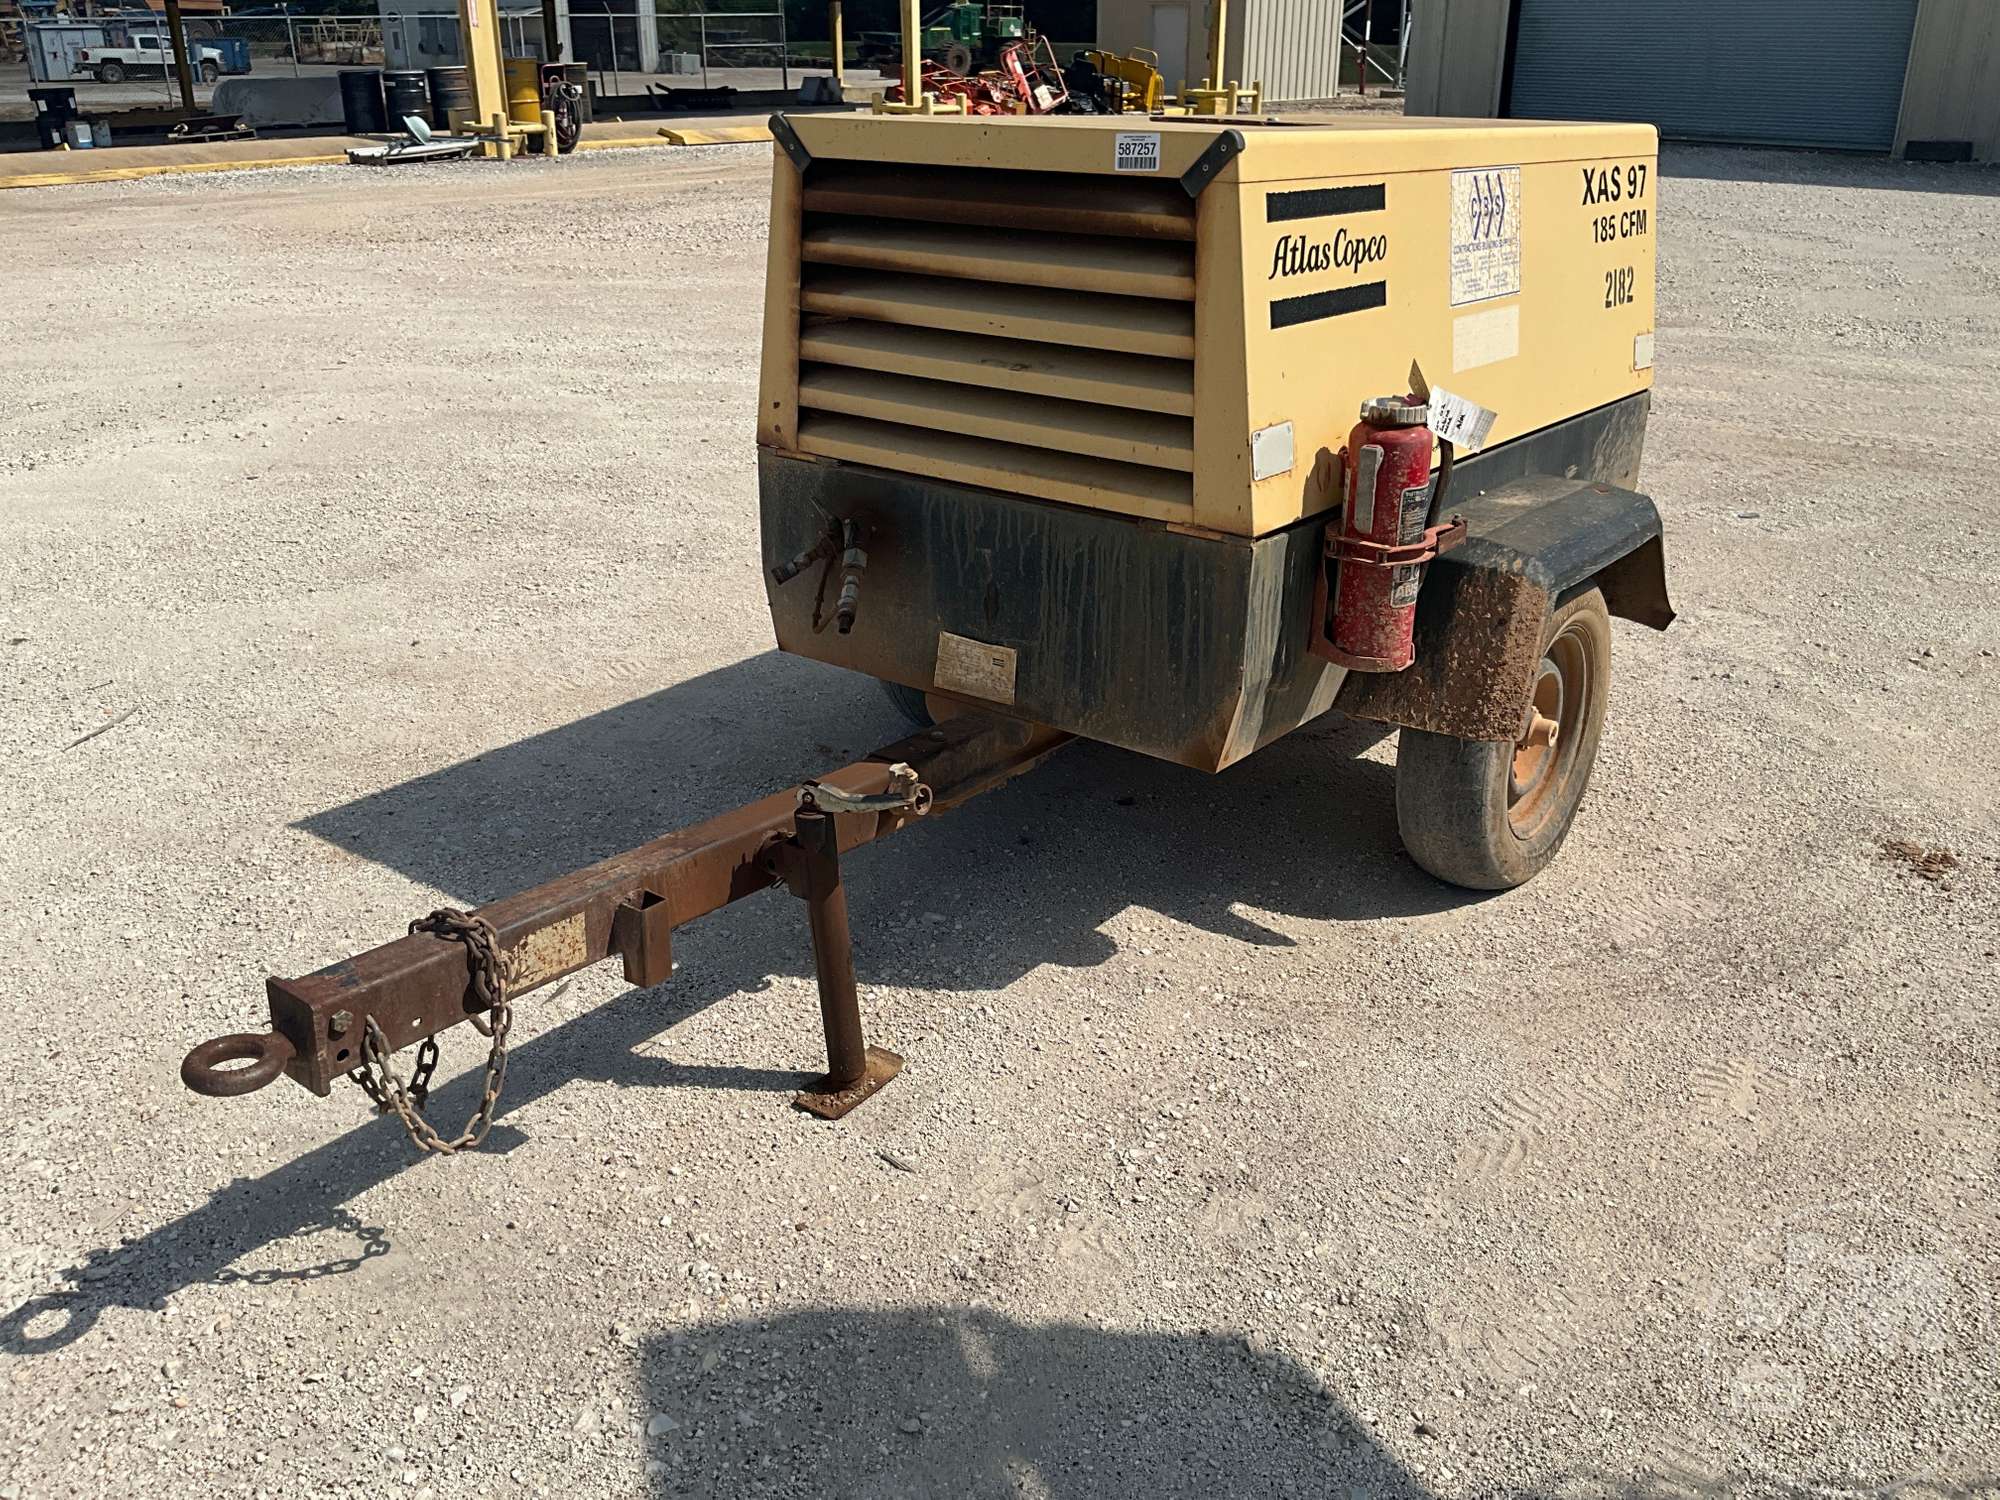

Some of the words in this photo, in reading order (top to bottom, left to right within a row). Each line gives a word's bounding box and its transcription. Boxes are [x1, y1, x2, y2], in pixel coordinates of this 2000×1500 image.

[1118, 142, 1157, 156] 587257
[1582, 165, 1621, 206] XAS
[1627, 164, 1647, 200] 97
[1592, 214, 1616, 243] 185
[1620, 209, 1647, 239] CFM
[1268, 234, 1331, 280] Atlas
[1333, 228, 1387, 274] Copco
[1605, 266, 1634, 309] 2182
